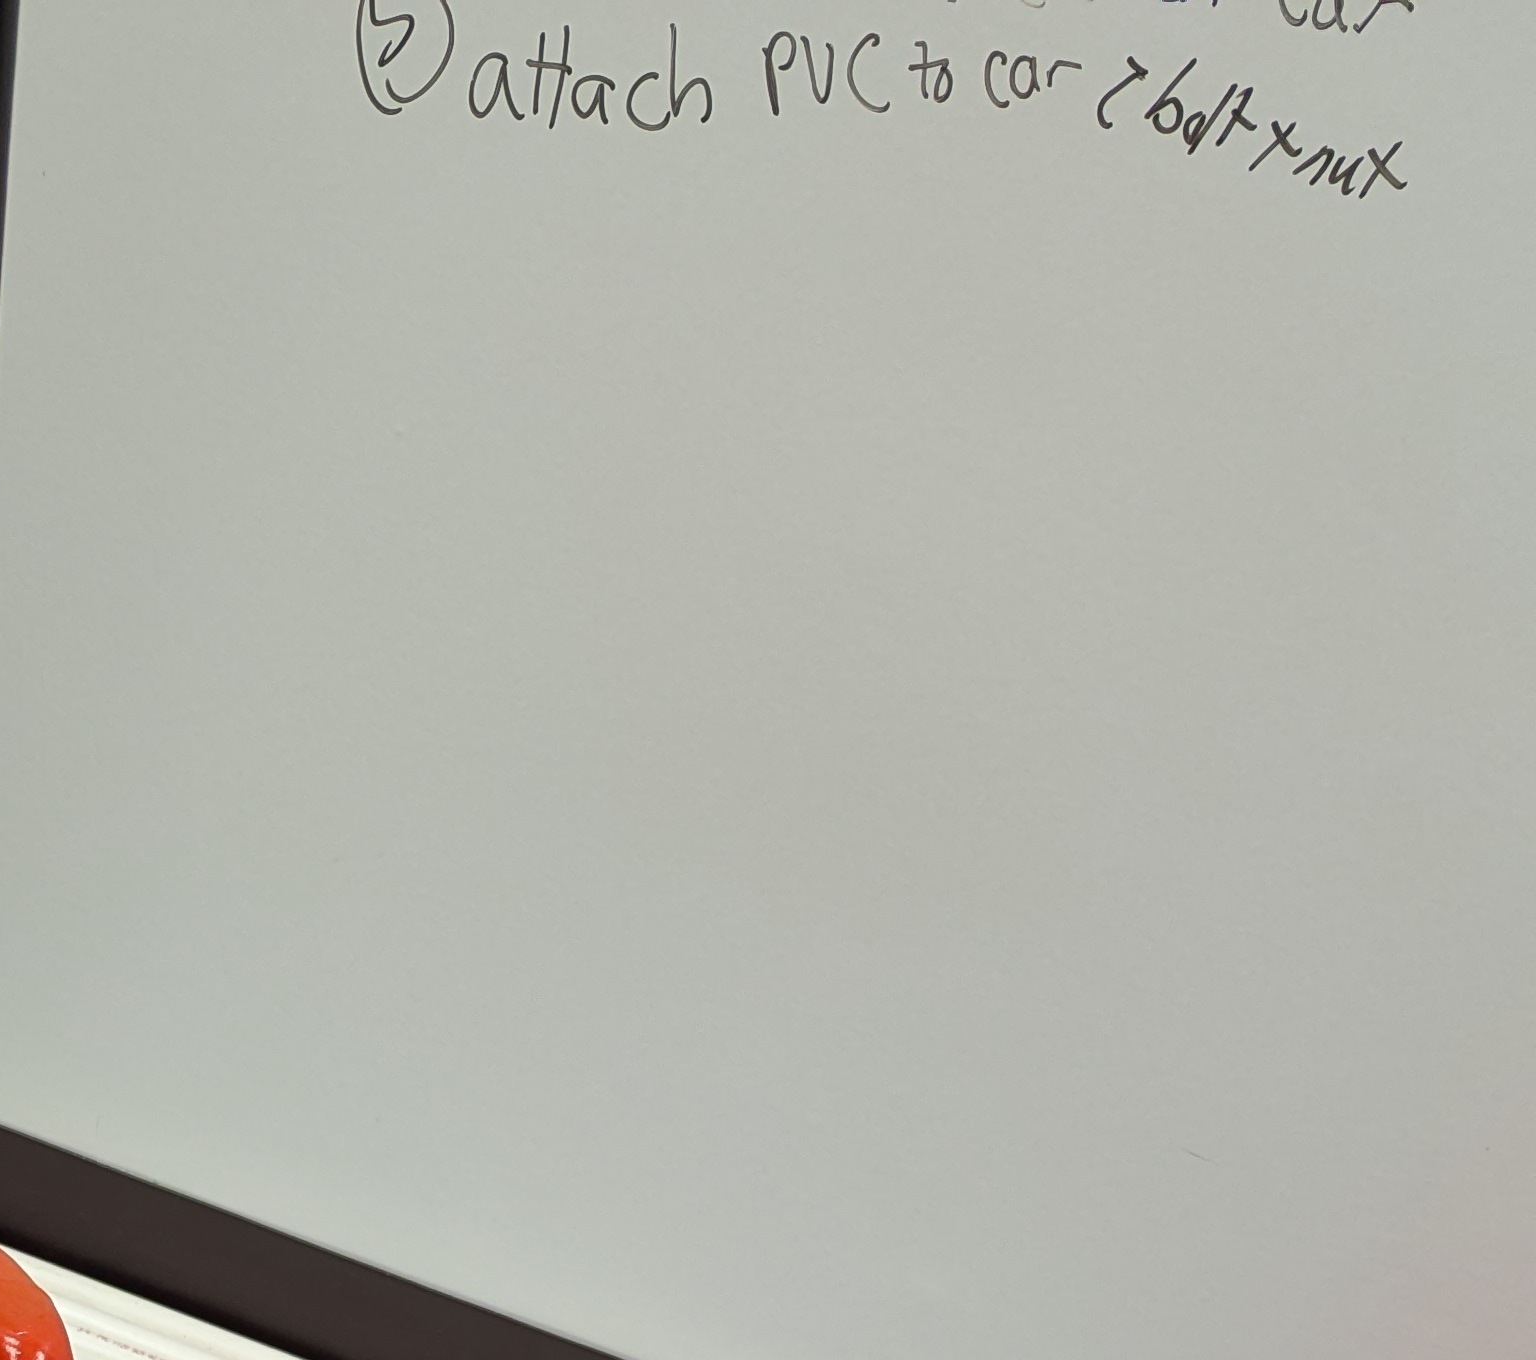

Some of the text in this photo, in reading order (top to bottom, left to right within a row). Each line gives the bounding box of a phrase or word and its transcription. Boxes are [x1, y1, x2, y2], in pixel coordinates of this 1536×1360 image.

[468, 23, 713, 131] attach
[762, 31, 891, 116] PVC
[908, 41, 955, 104] to
[983, 50, 1083, 109] car
